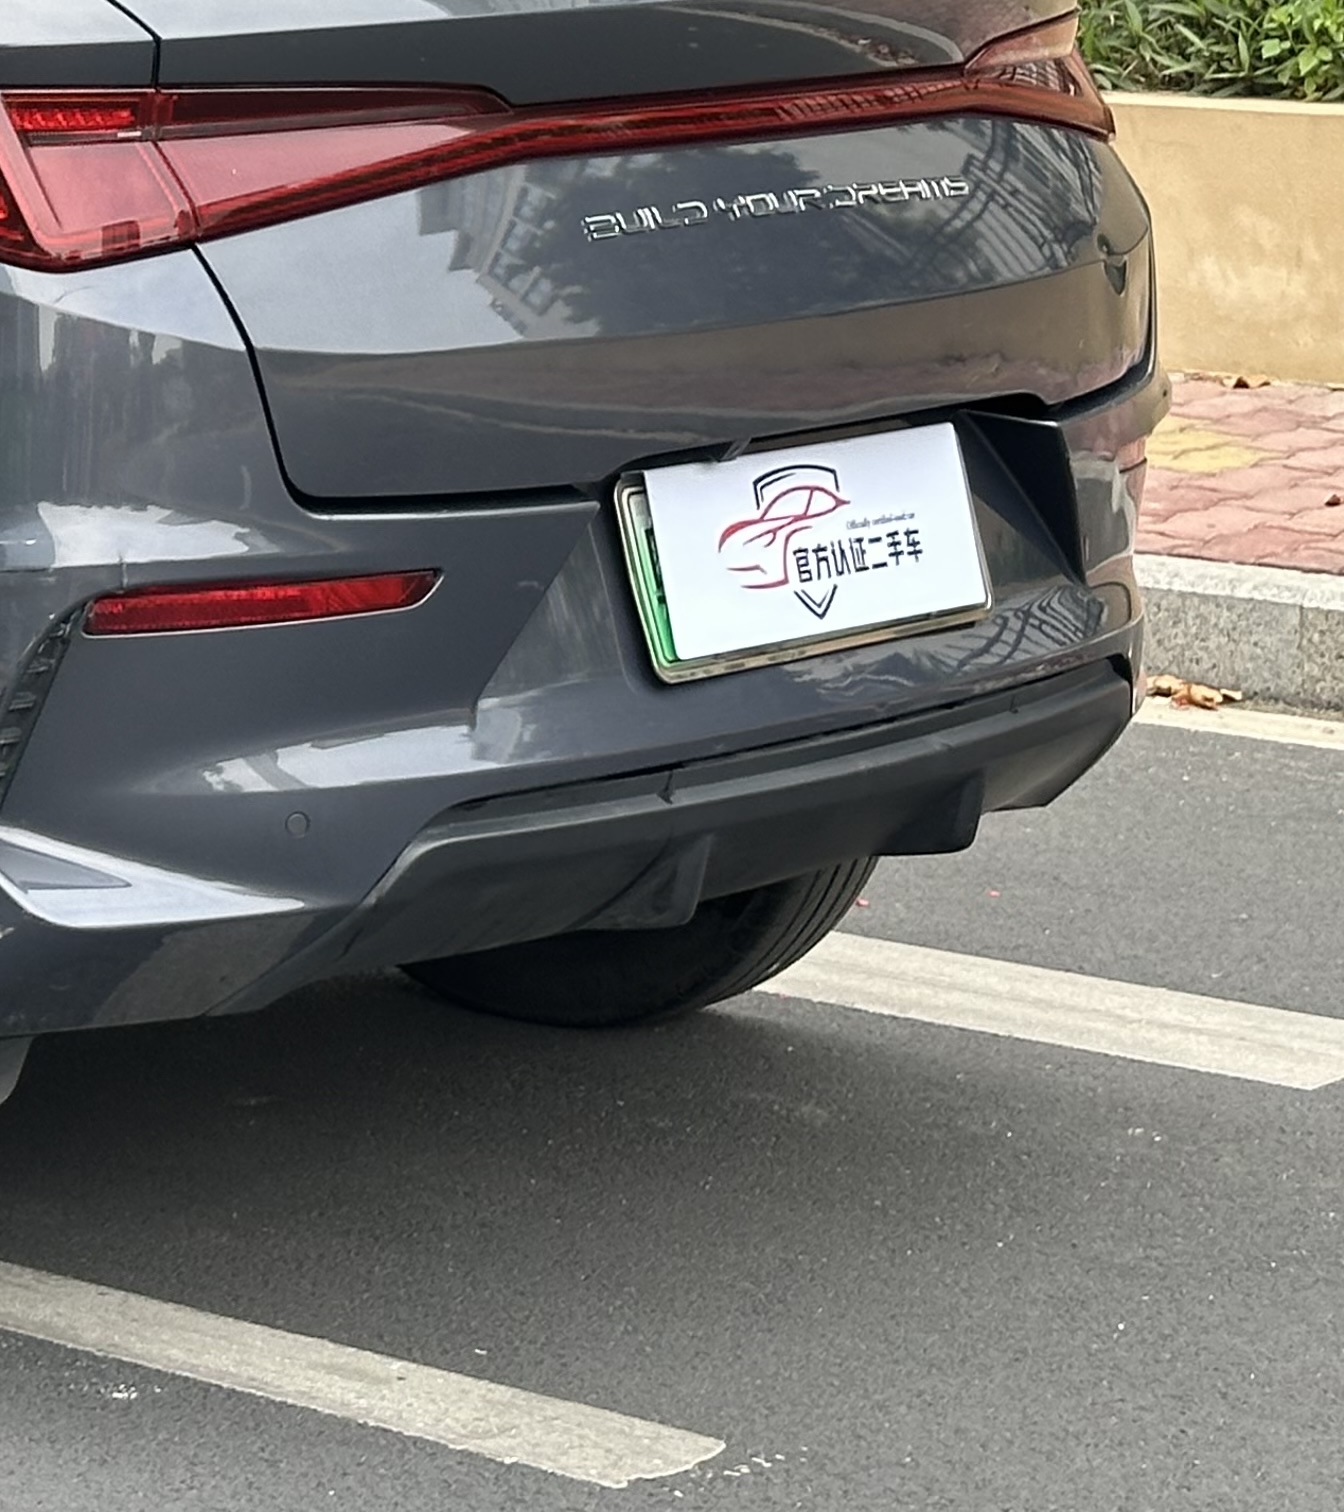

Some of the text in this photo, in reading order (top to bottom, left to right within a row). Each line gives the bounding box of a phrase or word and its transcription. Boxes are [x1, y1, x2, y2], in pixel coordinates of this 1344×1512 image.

[581, 174, 970, 241] BUILD YOUR DREAMS
[793, 528, 923, 583] 官方认证二手车
